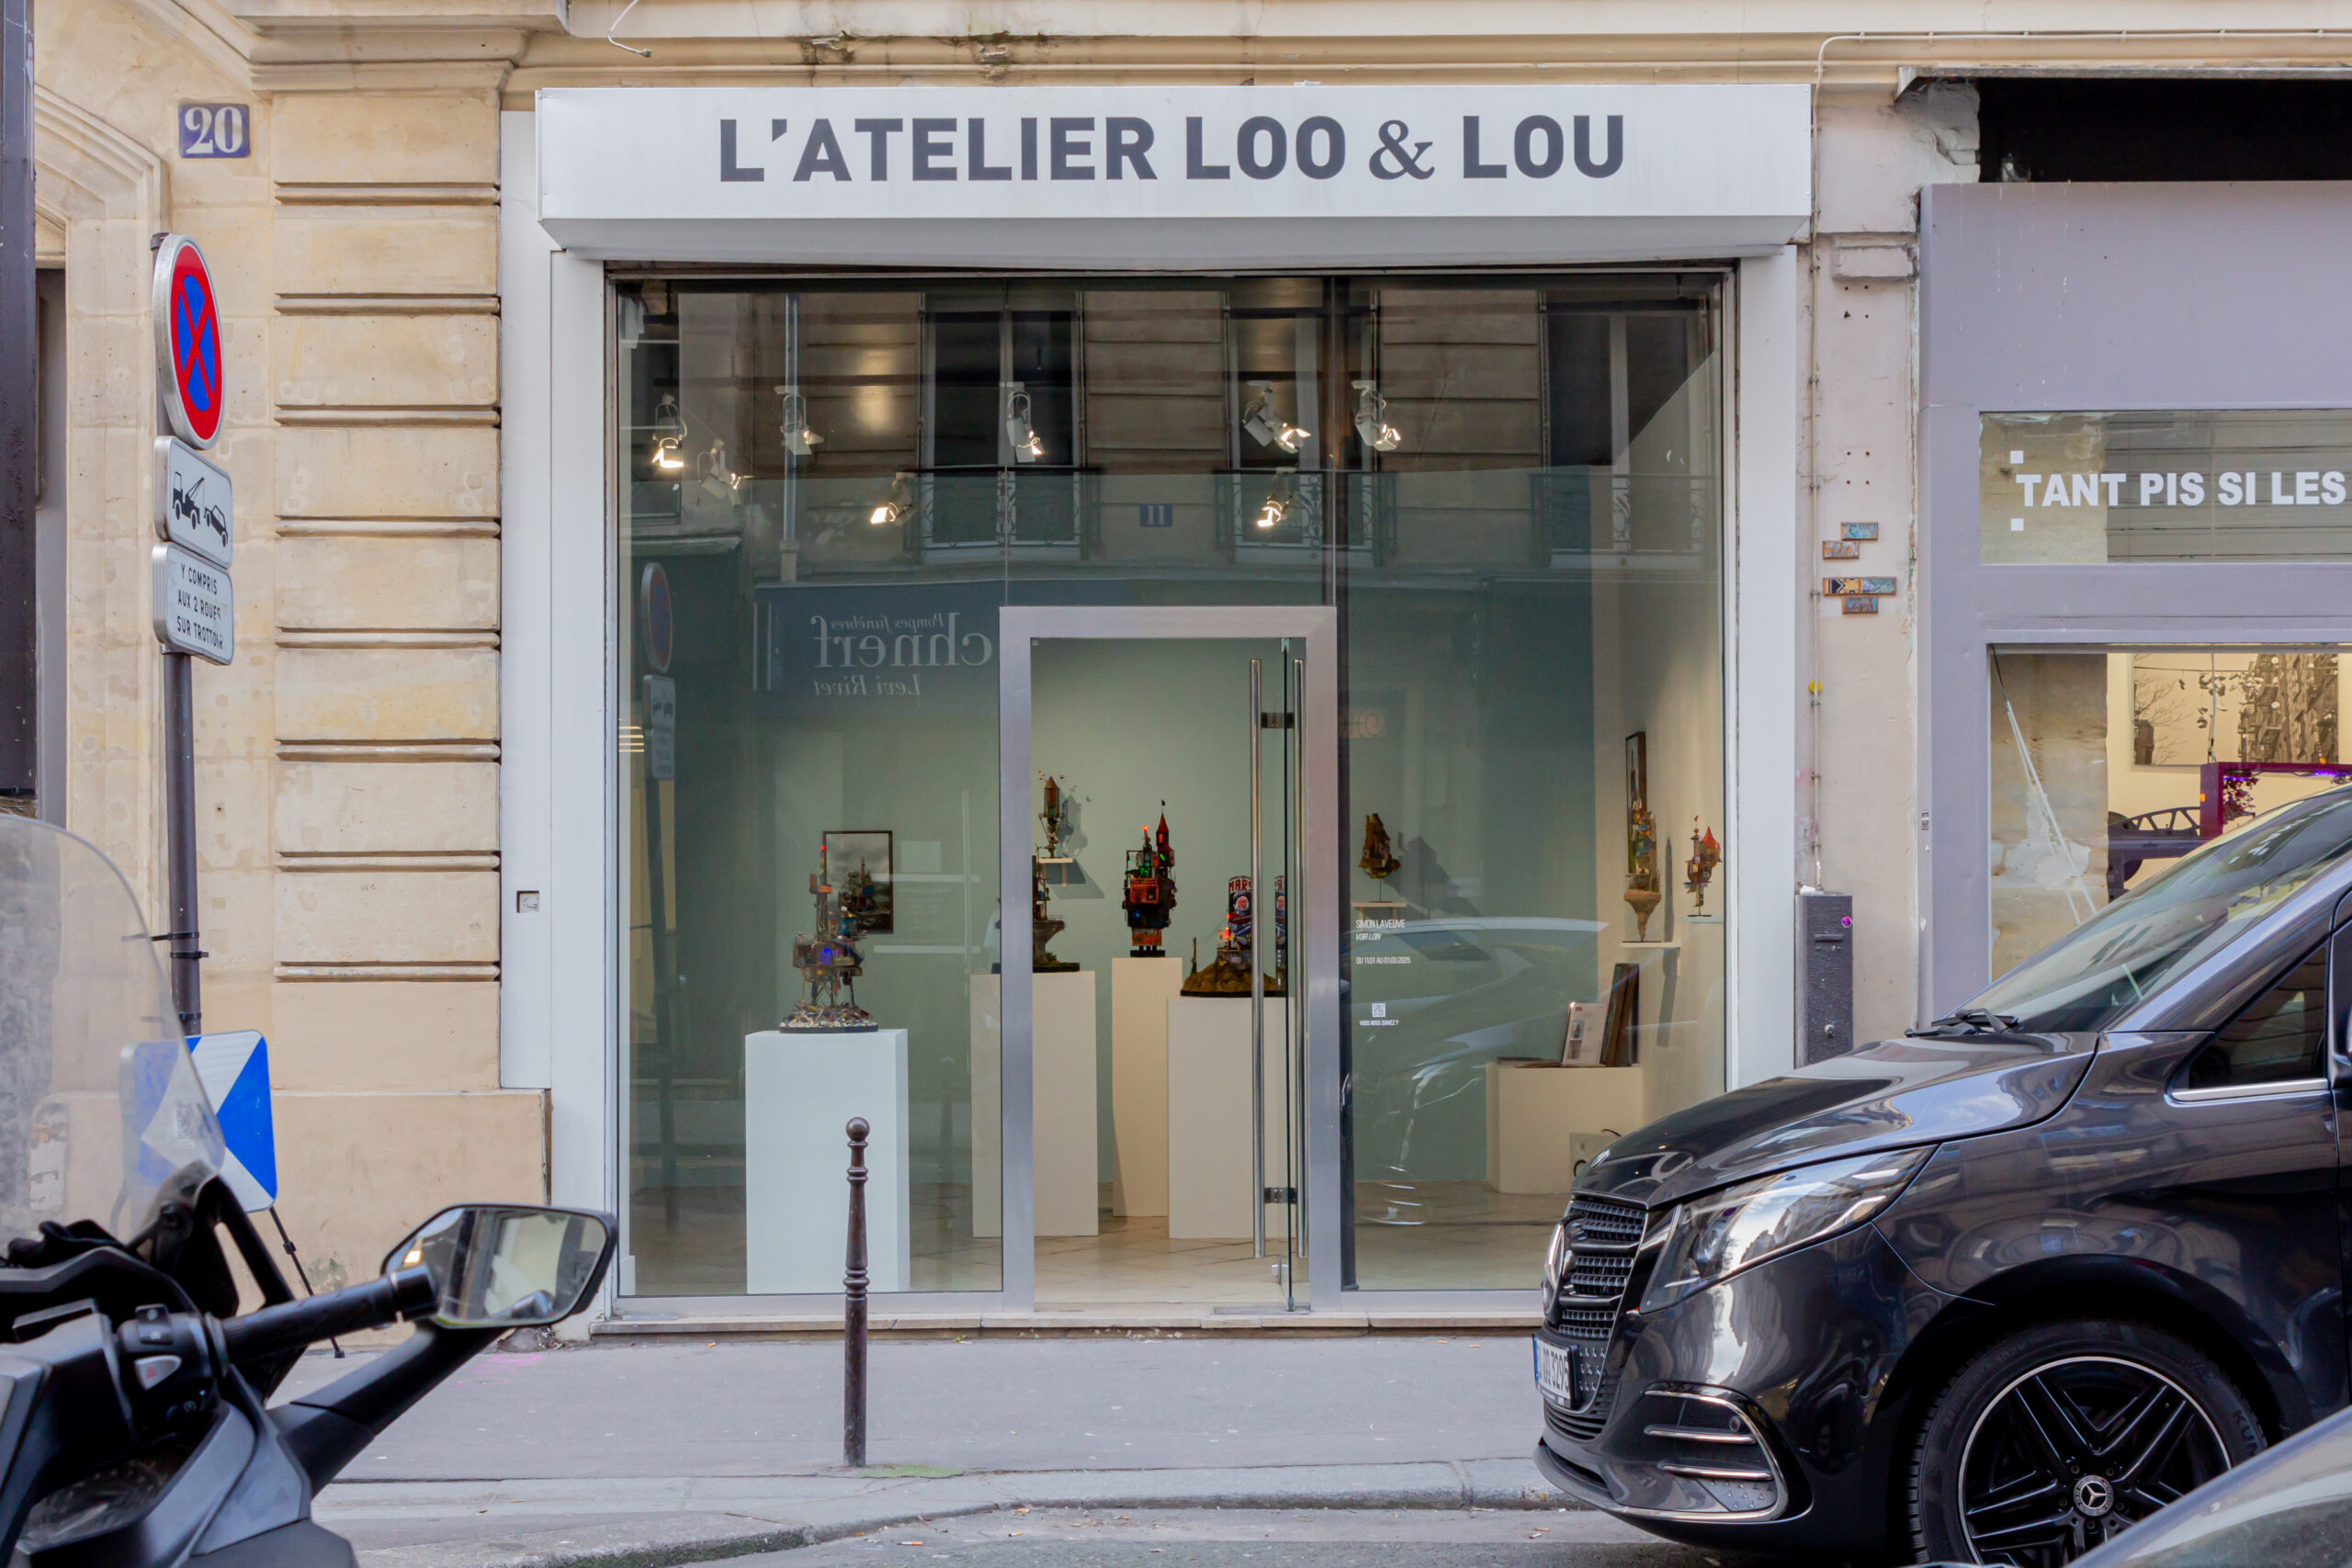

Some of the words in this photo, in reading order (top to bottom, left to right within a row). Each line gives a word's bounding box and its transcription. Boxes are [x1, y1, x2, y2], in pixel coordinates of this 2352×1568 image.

[184, 106, 243, 154] 20
[719, 117, 1159, 183] L'ATELIER
[1185, 116, 1346, 180] LOO
[1368, 118, 1435, 181] &
[1463, 114, 1623, 179] LOU
[2016, 473, 2126, 507] TANT
[2140, 472, 2205, 506] PIS
[2217, 471, 2256, 505] SI
[2271, 471, 2346, 505] LES
[180, 563, 186, 580] Y
[188, 567, 218, 595] COMPRIS
[177, 588, 191, 610] AUX
[193, 595, 198, 613] 2
[199, 599, 221, 621] ROUES
[176, 615, 191, 637] SUR
[193, 622, 223, 649] TROTTOIR
[1355, 919, 1375, 929] SIMON
[1376, 919, 1406, 929] LAVEUVE
[1355, 932, 1368, 941] VOIR
[1368, 932, 1382, 941] LOIN
